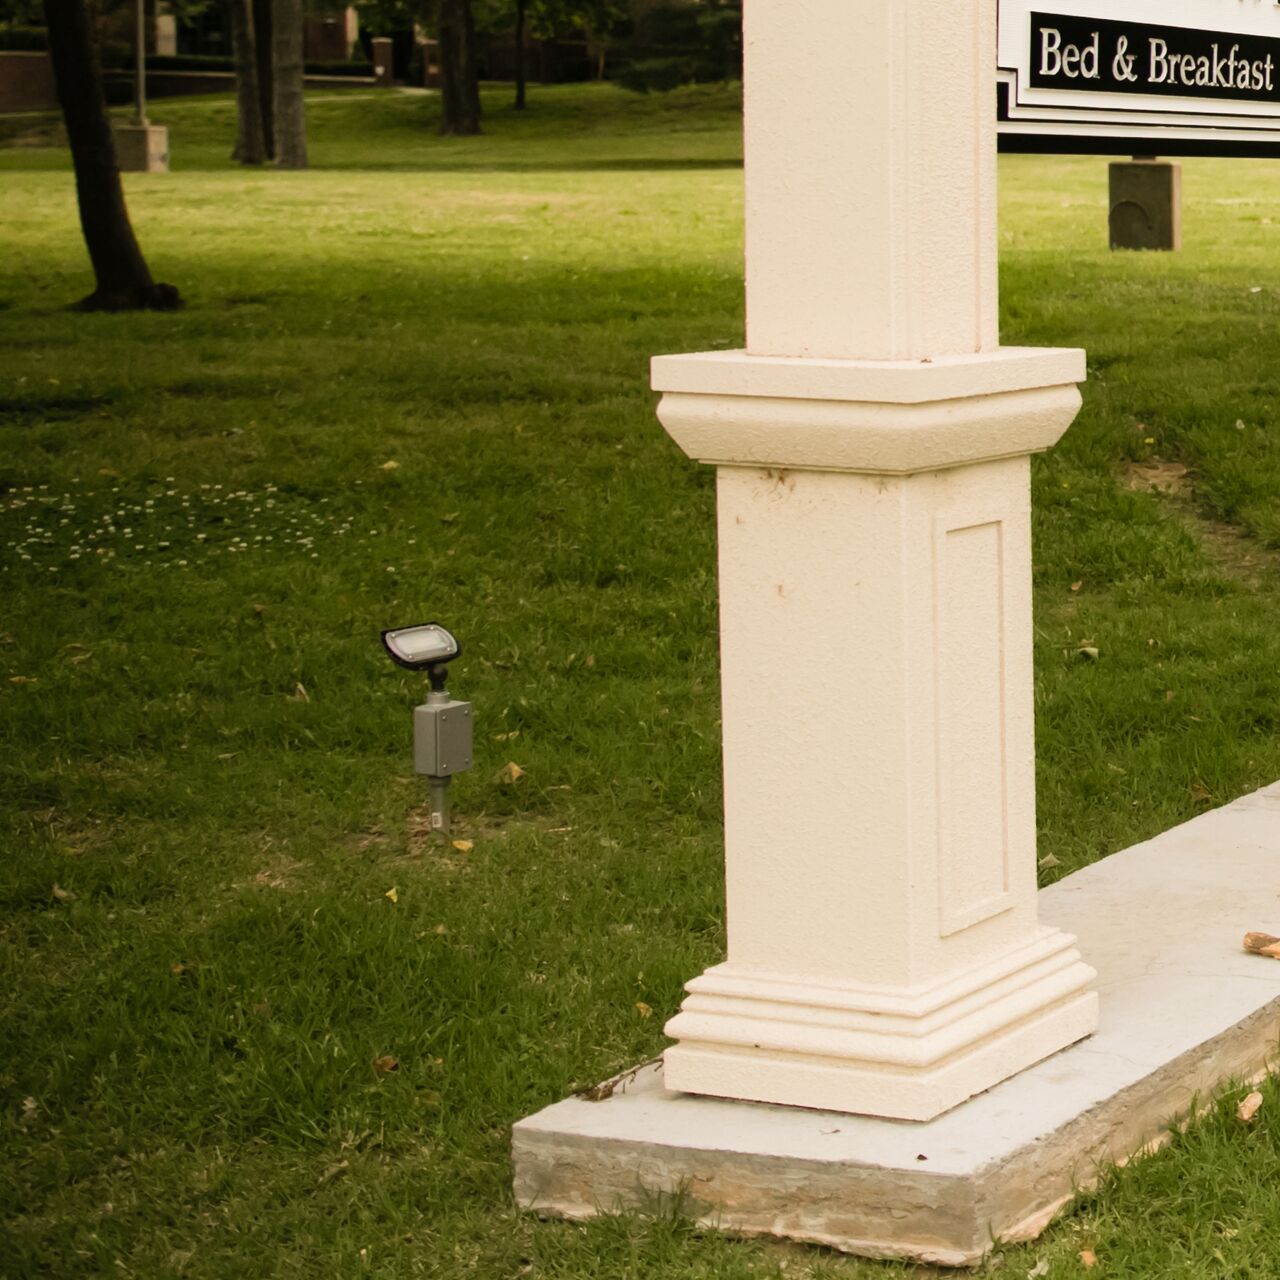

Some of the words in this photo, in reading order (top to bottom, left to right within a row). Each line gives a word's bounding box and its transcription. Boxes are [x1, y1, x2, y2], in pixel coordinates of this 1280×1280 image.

[1038, 27, 1101, 80] Bed
[1112, 34, 1138, 82] &
[1147, 37, 1275, 92] Breakfast
